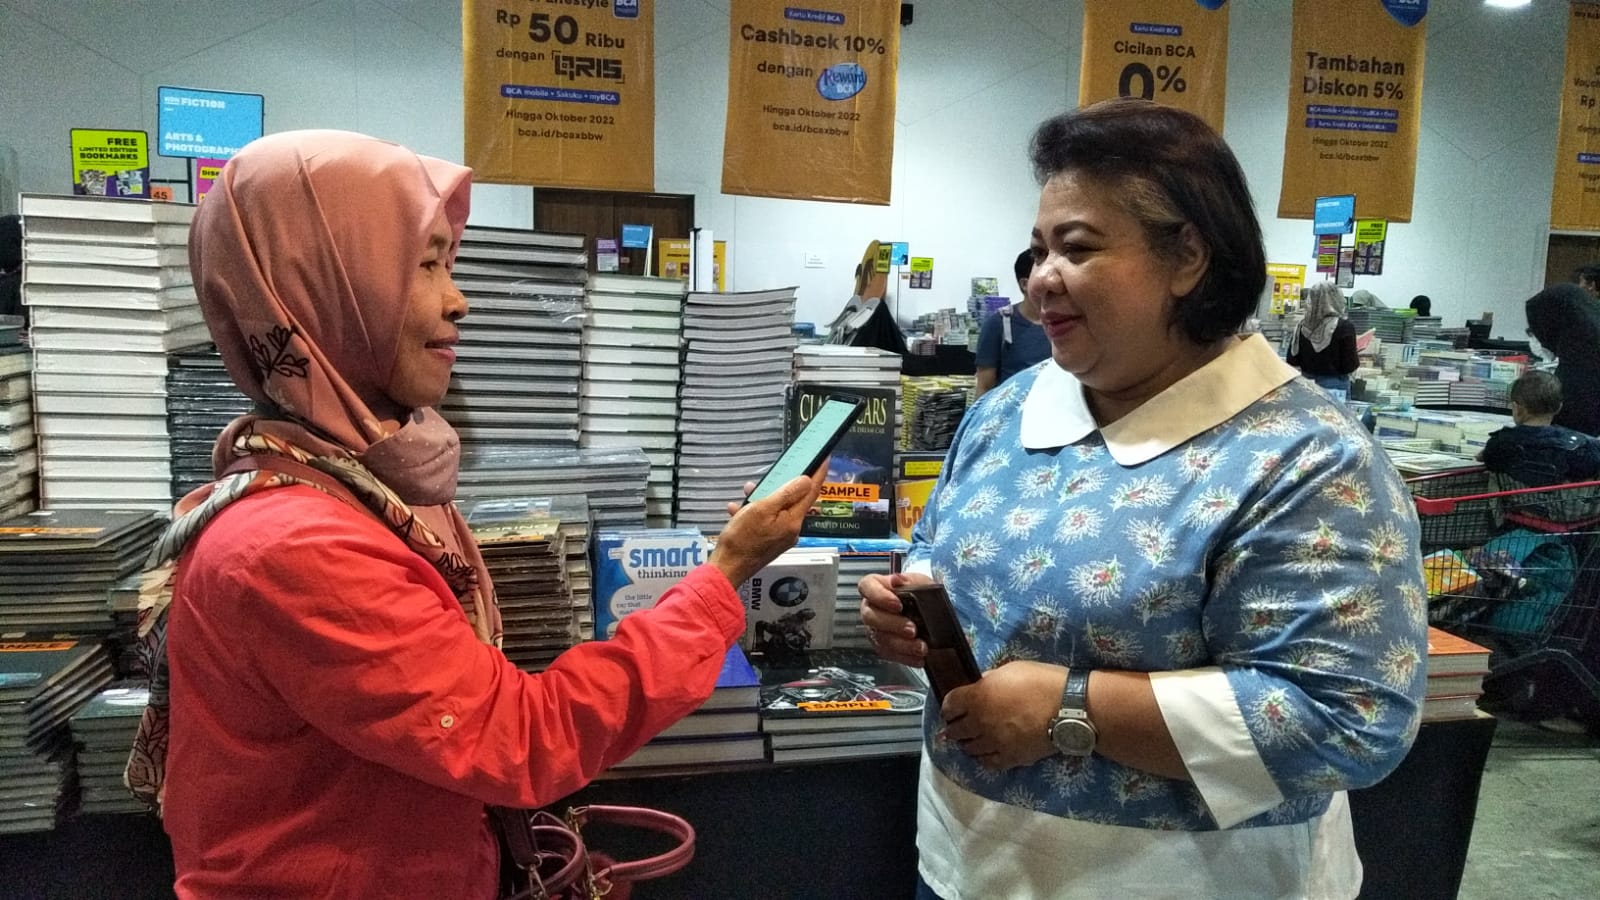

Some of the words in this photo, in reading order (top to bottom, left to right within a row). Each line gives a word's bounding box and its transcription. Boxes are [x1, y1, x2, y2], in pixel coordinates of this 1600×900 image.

[827, 13, 841, 22] BCA
[497, 9, 520, 28] Rp
[529, 13, 578, 45] 50
[585, 33, 625, 49] Ribu
[741, 24, 839, 50] Cashback
[843, 35, 886, 55] 10%
[1114, 40, 1162, 56] Cicilan
[1166, 44, 1196, 58] BCA
[496, 48, 545, 62] dengan
[554, 54, 623, 81] QRIS
[757, 60, 813, 78] dengan
[1306, 51, 1405, 76] Tambahan
[823, 64, 864, 86] Reward
[1118, 62, 1187, 101] 0%
[505, 87, 521, 95] BCA
[524, 89, 548, 97] mobile
[836, 84, 854, 93] BCA
[1303, 76, 1369, 98] Diskon
[1373, 81, 1404, 100] 5%
[180, 98, 225, 109] FICTION
[506, 109, 542, 122] Hingga
[544, 112, 588, 123] Oktober
[589, 115, 615, 125] 2022
[763, 104, 796, 117] Hingga
[797, 108, 836, 118] Oktober
[837, 112, 861, 121] 2022
[107, 137, 137, 146] FREE
[164, 132, 194, 141] ARTS
[518, 127, 603, 141] bca.id/bcaxbbw
[821, 486, 871, 497] SAMPLE
[840, 522, 861, 530] LONG
[629, 541, 703, 569] smart
[637, 569, 688, 579] thinking
[751, 577, 763, 611] BMW
